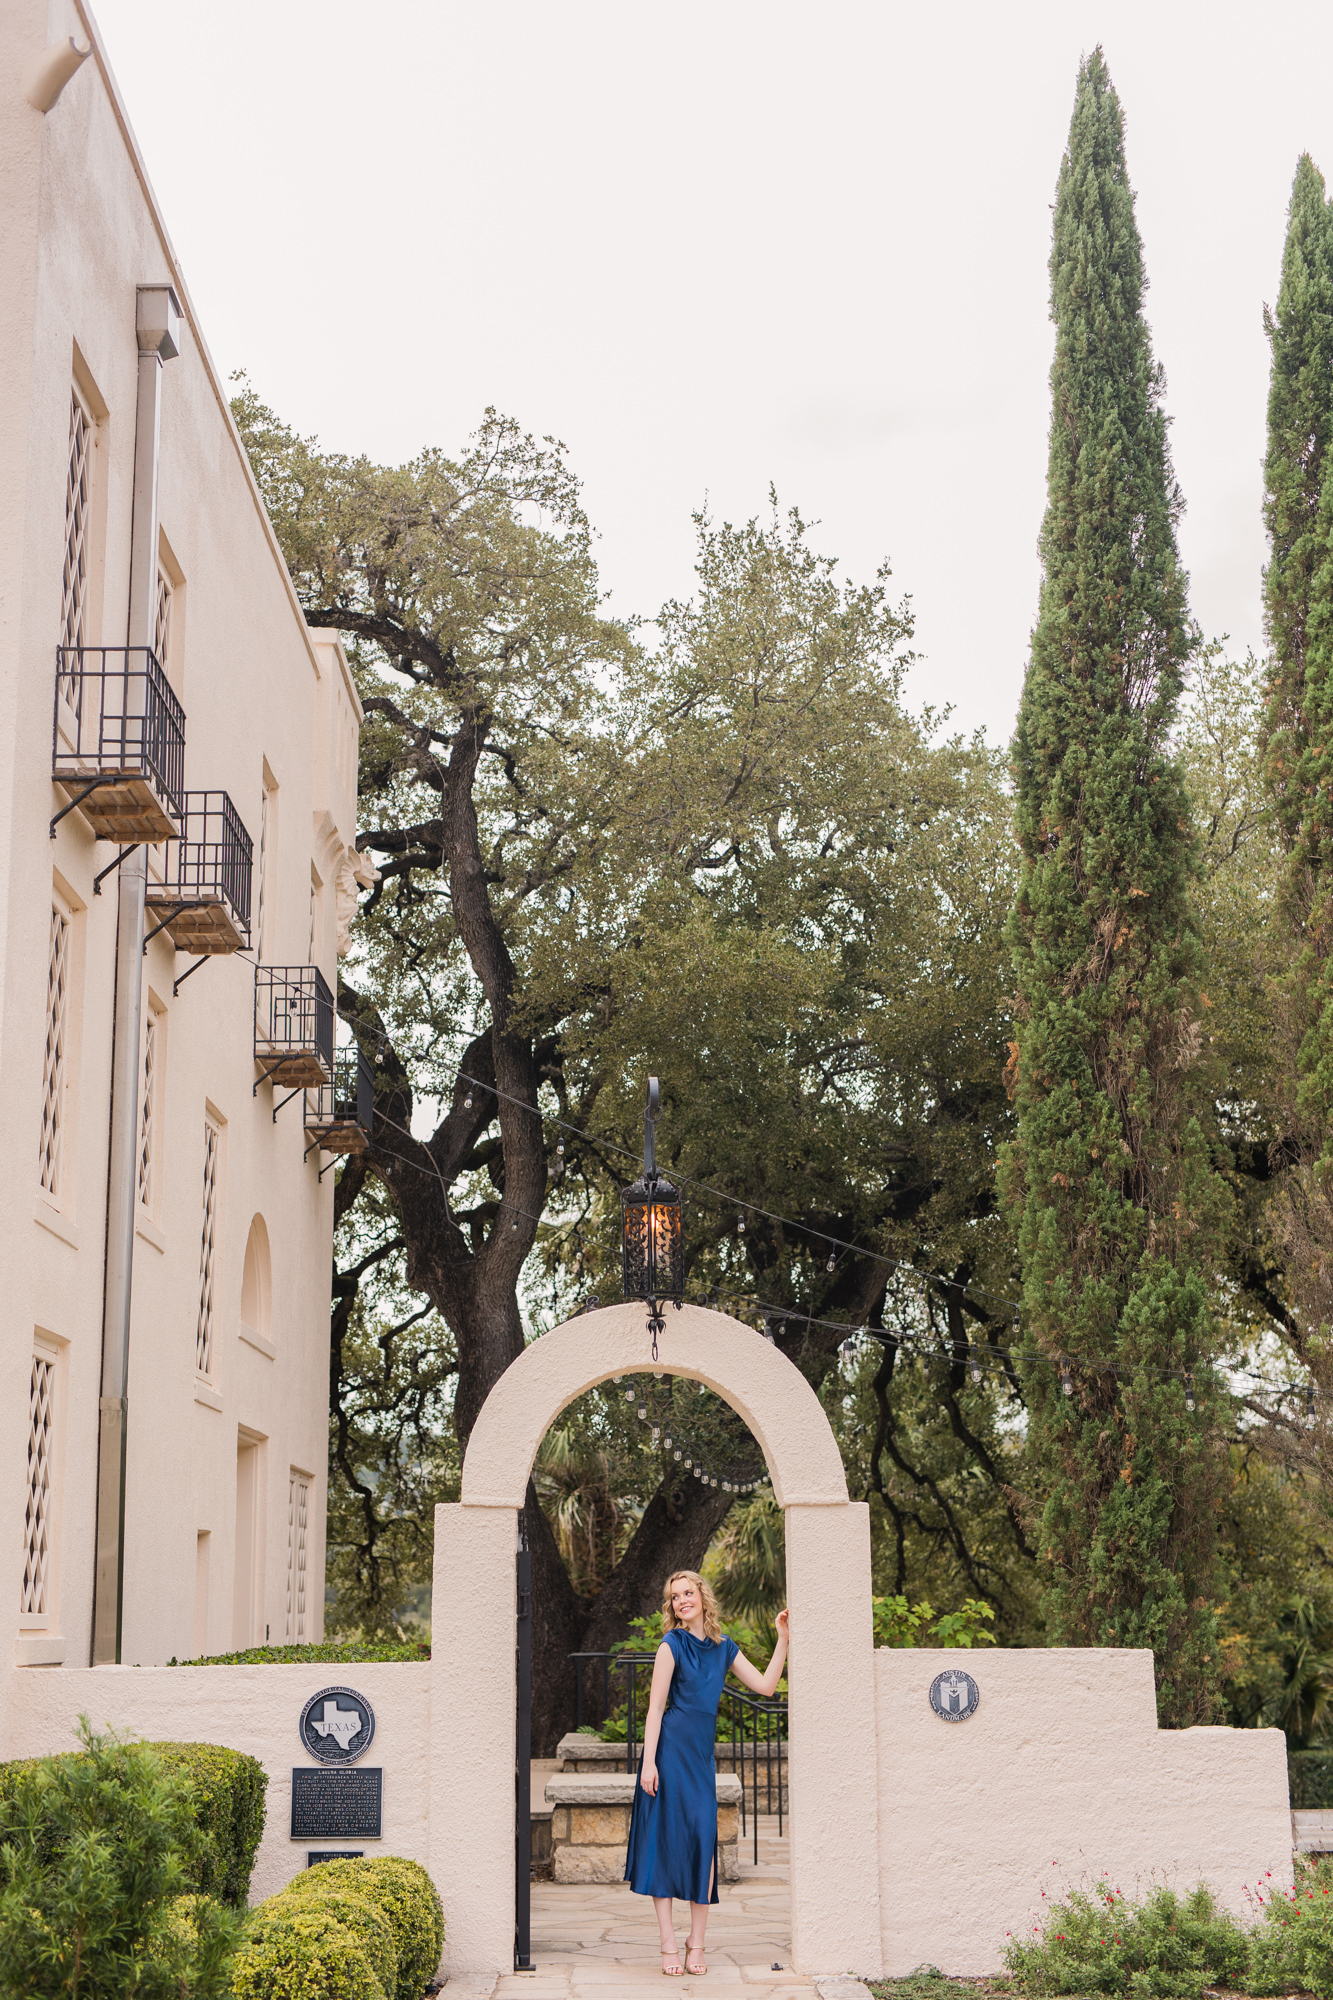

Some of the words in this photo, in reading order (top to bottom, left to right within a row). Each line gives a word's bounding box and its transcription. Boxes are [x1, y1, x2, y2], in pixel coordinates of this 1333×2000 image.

[302, 1701, 313, 1716] TEXAS
[314, 1687, 346, 1698] HISTORICAL
[937, 1709, 972, 1721] LANDMARK
[321, 1722, 356, 1732] TEXAS
